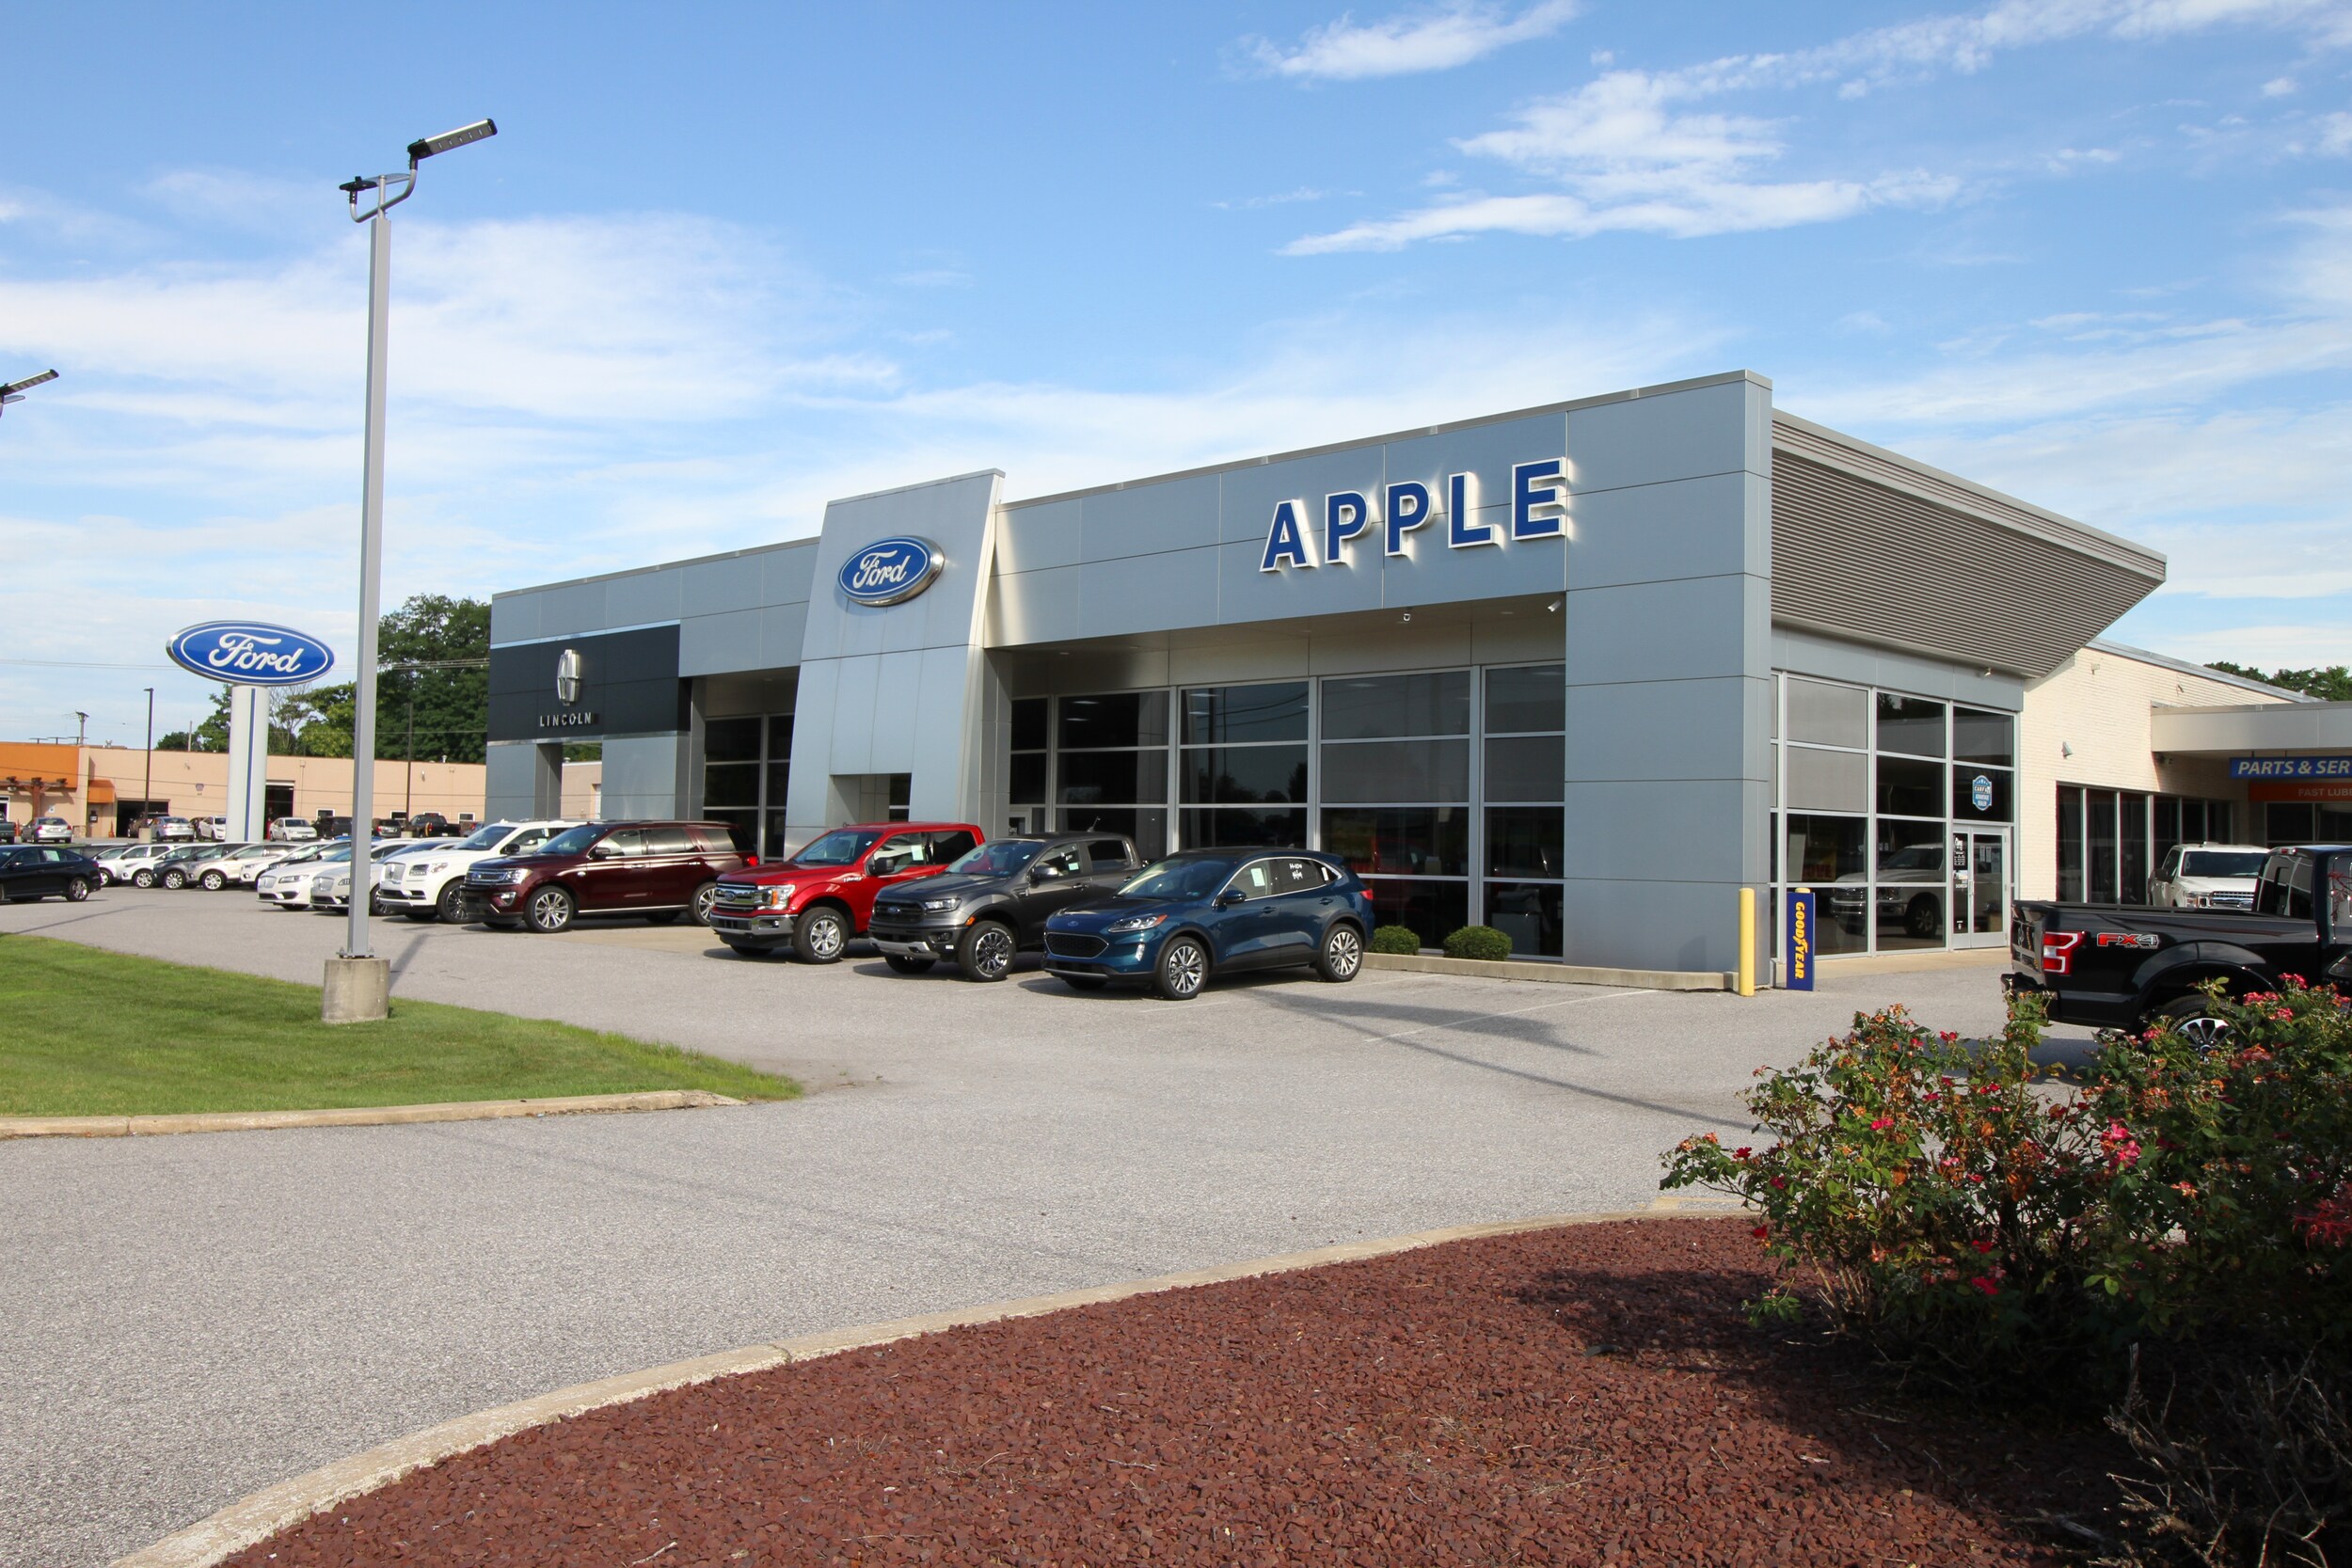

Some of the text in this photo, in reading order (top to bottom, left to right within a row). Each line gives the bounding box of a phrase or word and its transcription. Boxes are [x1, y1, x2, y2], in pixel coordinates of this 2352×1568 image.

[1260, 456, 1566, 572] APPLE
[852, 549, 911, 589] Ford
[209, 632, 305, 673] Ford
[539, 712, 592, 727] LINCOLN
[2238, 761, 2294, 775] PARTS
[2297, 760, 2312, 774] &
[2298, 788, 2324, 797] FAST
[1793, 901, 1808, 980] GOODYEAR
[2097, 932, 2160, 947] FX4
